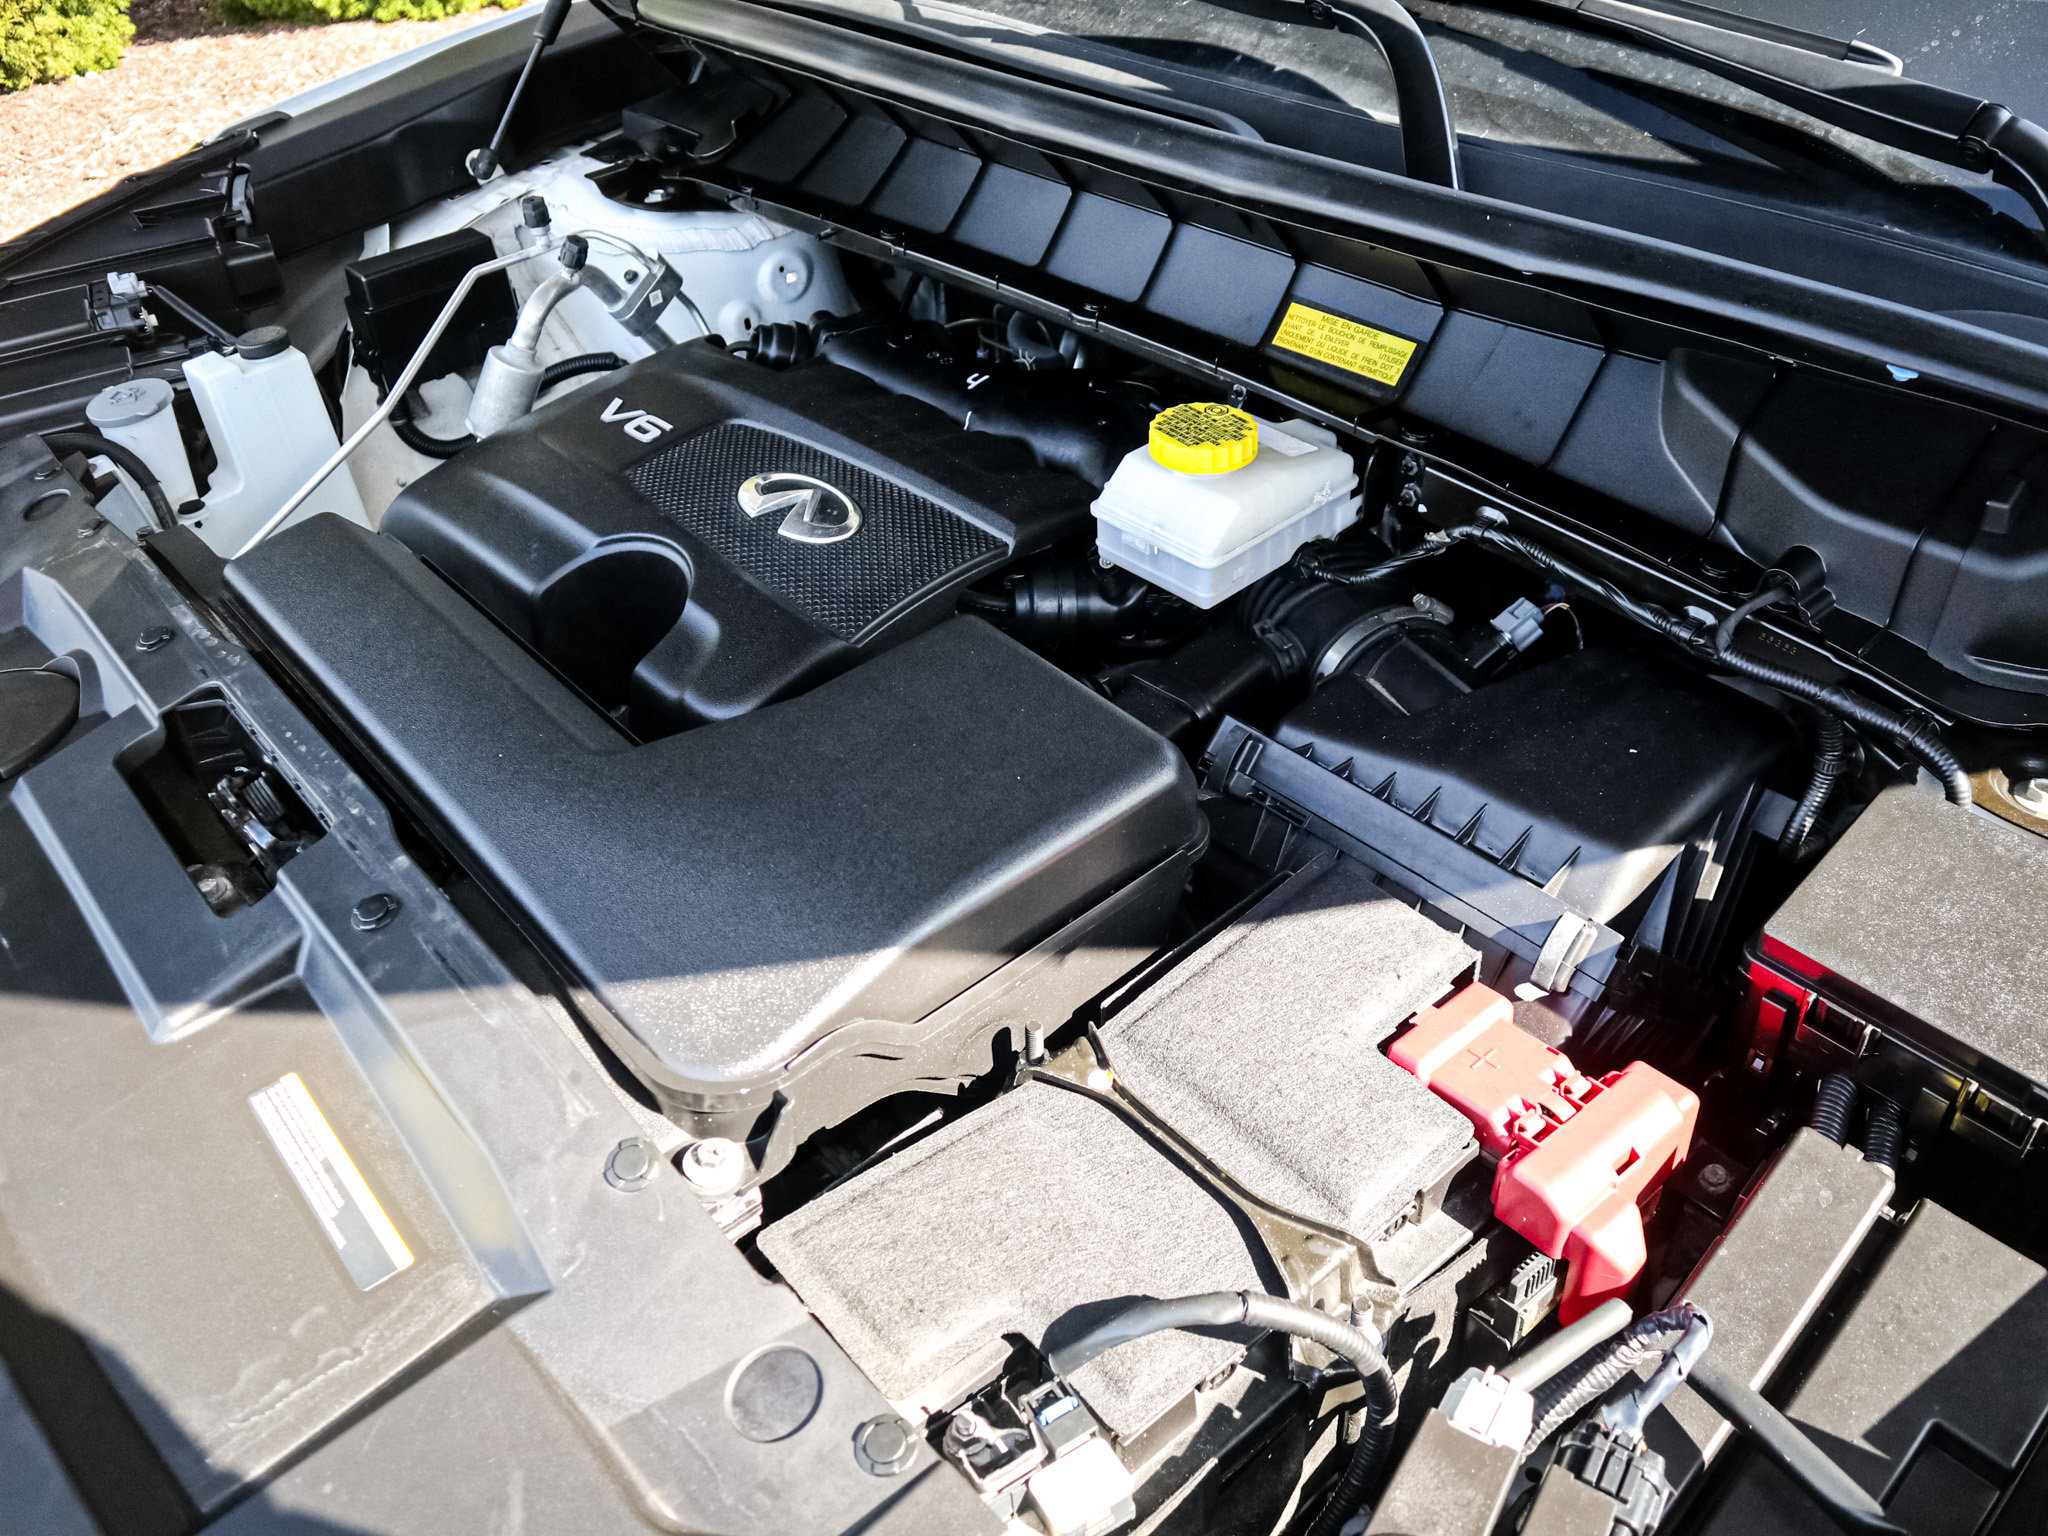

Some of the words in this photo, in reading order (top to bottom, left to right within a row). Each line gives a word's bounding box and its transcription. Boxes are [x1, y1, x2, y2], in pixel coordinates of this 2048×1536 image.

[1284, 321, 1303, 331] AVANT
[1306, 328, 1315, 336] DE
[1320, 333, 1349, 347] L'ENLEVER
[1379, 353, 1405, 366] UTILISER
[1287, 313, 1316, 327] NETTOYER
[1318, 322, 1326, 331] LE
[1328, 326, 1356, 340] BOUCHON
[1357, 335, 1366, 344] DE
[1369, 340, 1408, 358] REMPLISSAGE
[1321, 315, 1340, 327] MISE
[1341, 321, 1352, 331] EN
[1353, 325, 1381, 339] GARDE
[1276, 336, 1308, 351] PROVENANT
[1323, 353, 1357, 368] CONTENANT
[1280, 328, 1315, 344] UNIQUEMENT
[1316, 340, 1326, 348] DU
[1327, 344, 1350, 356] LIQUIDE
[1351, 352, 1359, 360] DE
[1361, 355, 1379, 366] FREIN
[1380, 362, 1394, 372] DOT
[600, 397, 674, 443] V6
